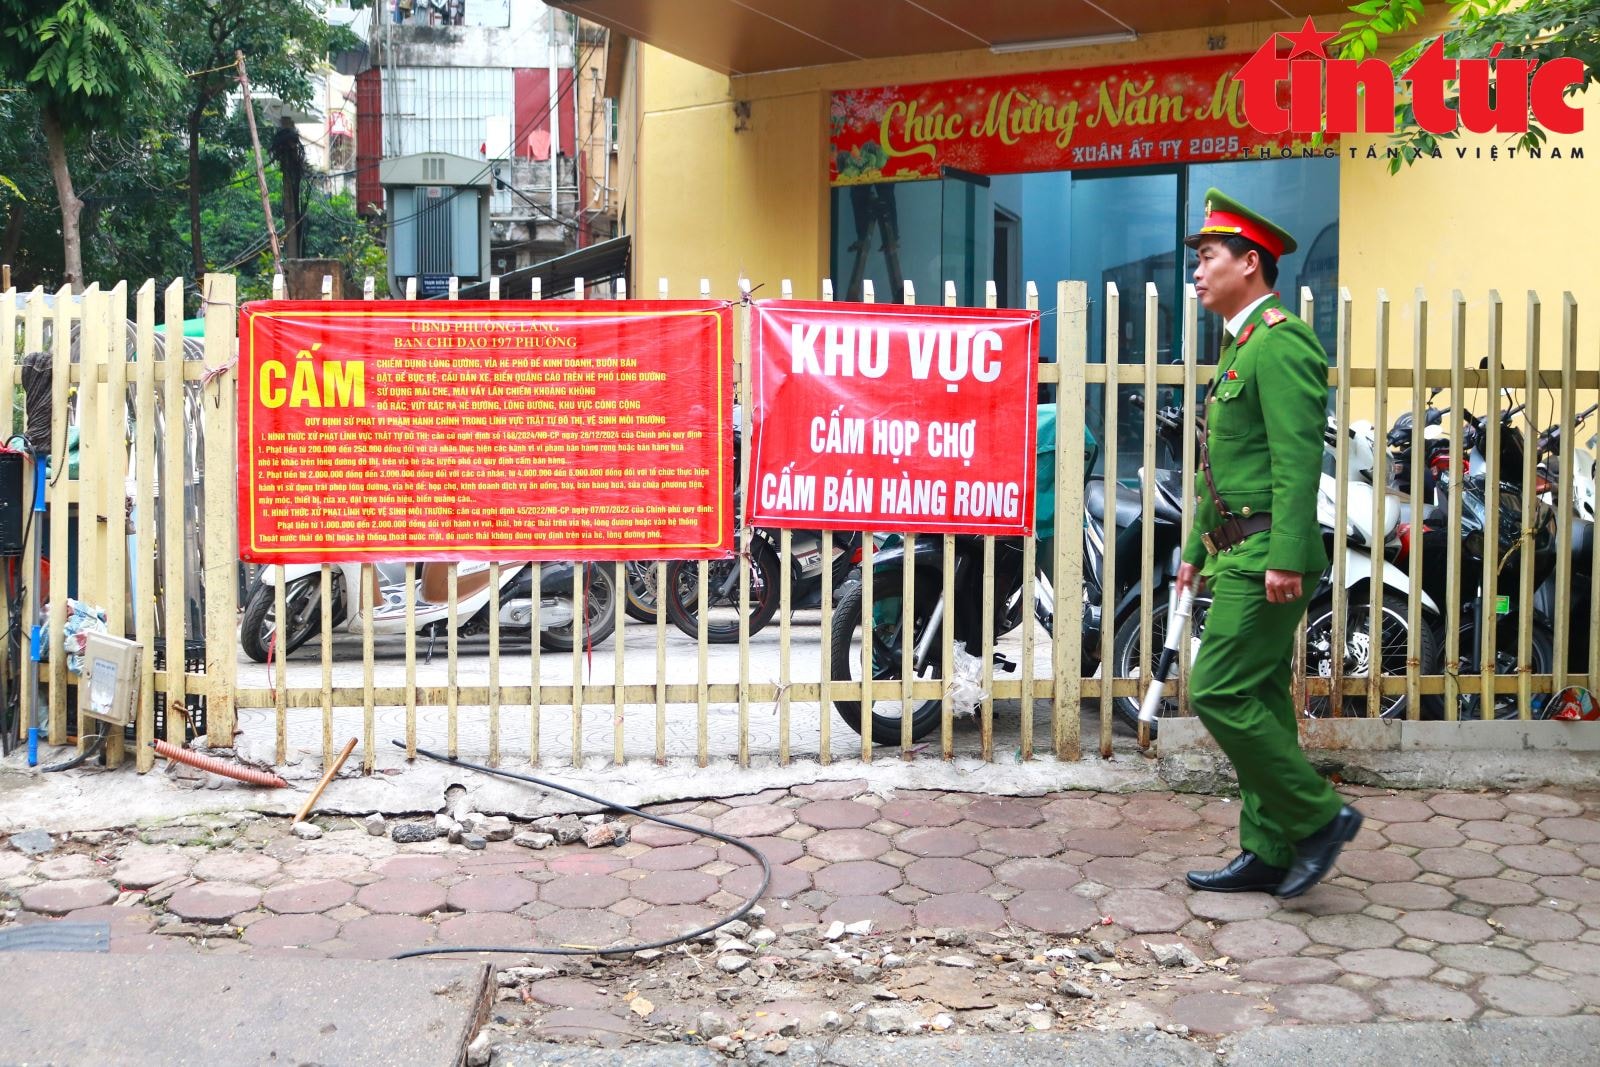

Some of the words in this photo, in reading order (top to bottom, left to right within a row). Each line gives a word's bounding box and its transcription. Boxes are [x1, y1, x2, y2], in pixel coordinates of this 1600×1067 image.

[880, 101, 963, 160] Chúc
[970, 90, 1078, 149] Mừng
[1086, 78, 1187, 128] Năm
[1072, 142, 1123, 163] XUÂN
[1129, 137, 1154, 160] ẤT
[1190, 136, 1239, 155] 2025
[394, 337, 423, 348] BAN
[492, 337, 512, 348] 197
[515, 334, 577, 348] PHƯỜNG
[411, 320, 450, 333] UBND
[259, 342, 366, 409] CẤM
[542, 358, 562, 367] KINH
[791, 324, 890, 379] KHU
[905, 326, 1004, 393] VỰC
[462, 416, 486, 424] TRONG
[810, 404, 865, 454] CẤM
[872, 419, 920, 464] HỌP
[927, 419, 977, 467] CHỢ
[761, 461, 816, 511] CẤM
[823, 469, 874, 513] BÁN
[880, 470, 947, 516] HÀNG
[953, 481, 1019, 518] RONG
